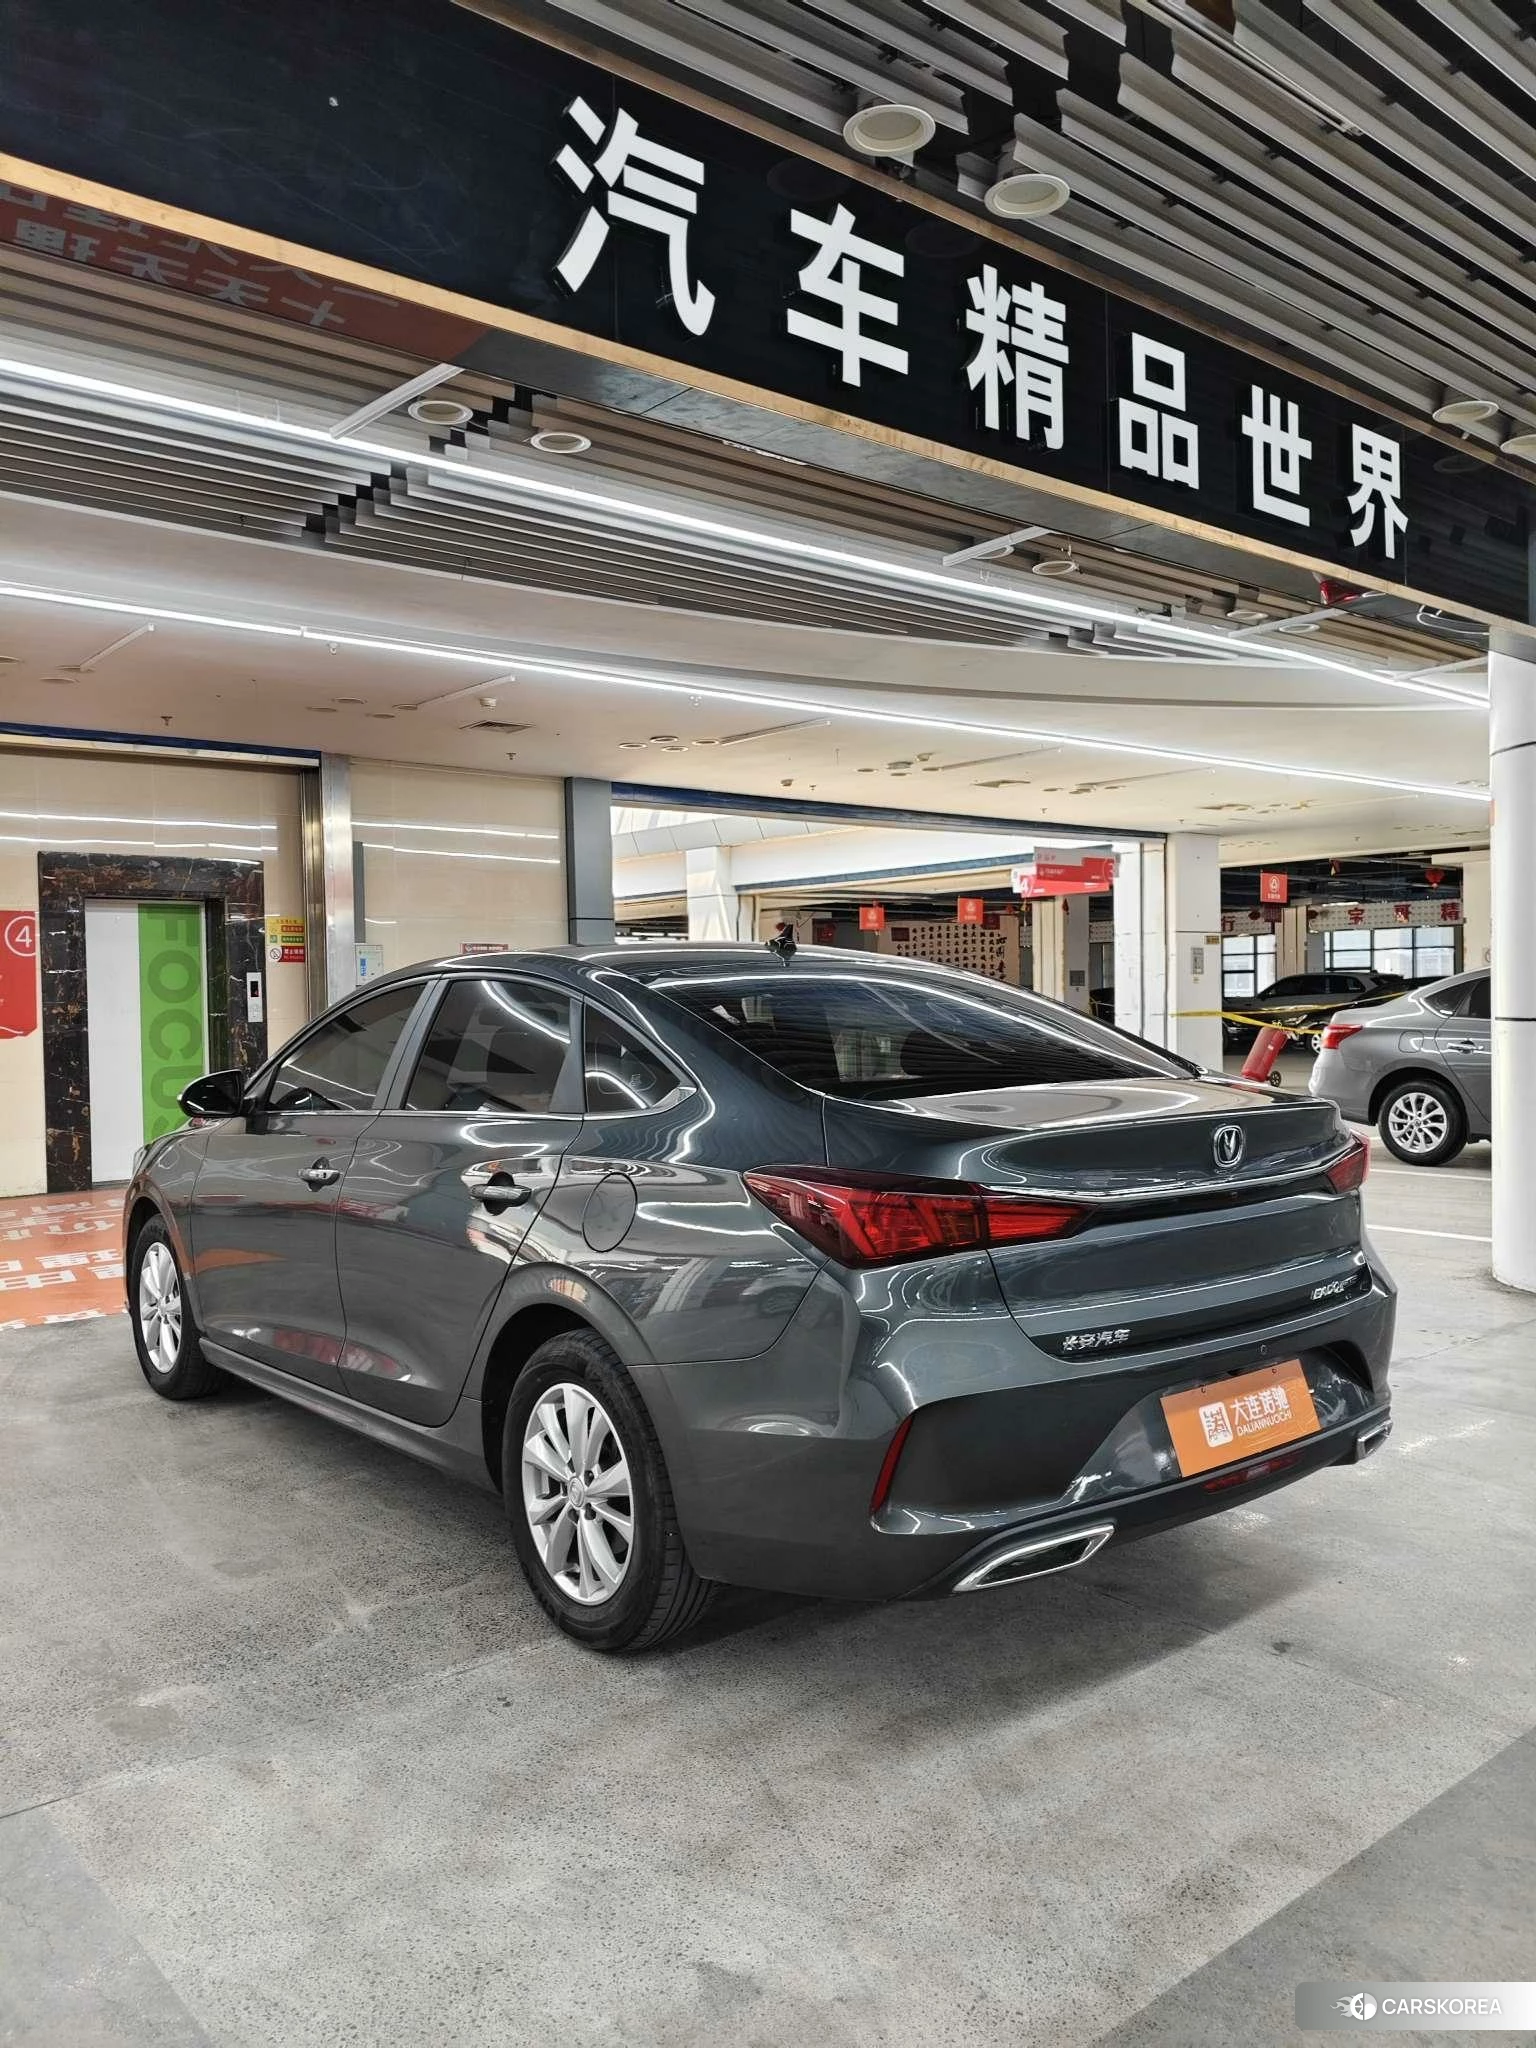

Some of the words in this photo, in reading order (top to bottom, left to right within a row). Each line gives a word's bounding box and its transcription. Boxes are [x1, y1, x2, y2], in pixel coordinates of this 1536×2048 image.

[555, 96, 1409, 559] 汽车精品世界
[15, 925, 32, 948] 4
[1063, 1329, 1132, 1351] 长安汽车
